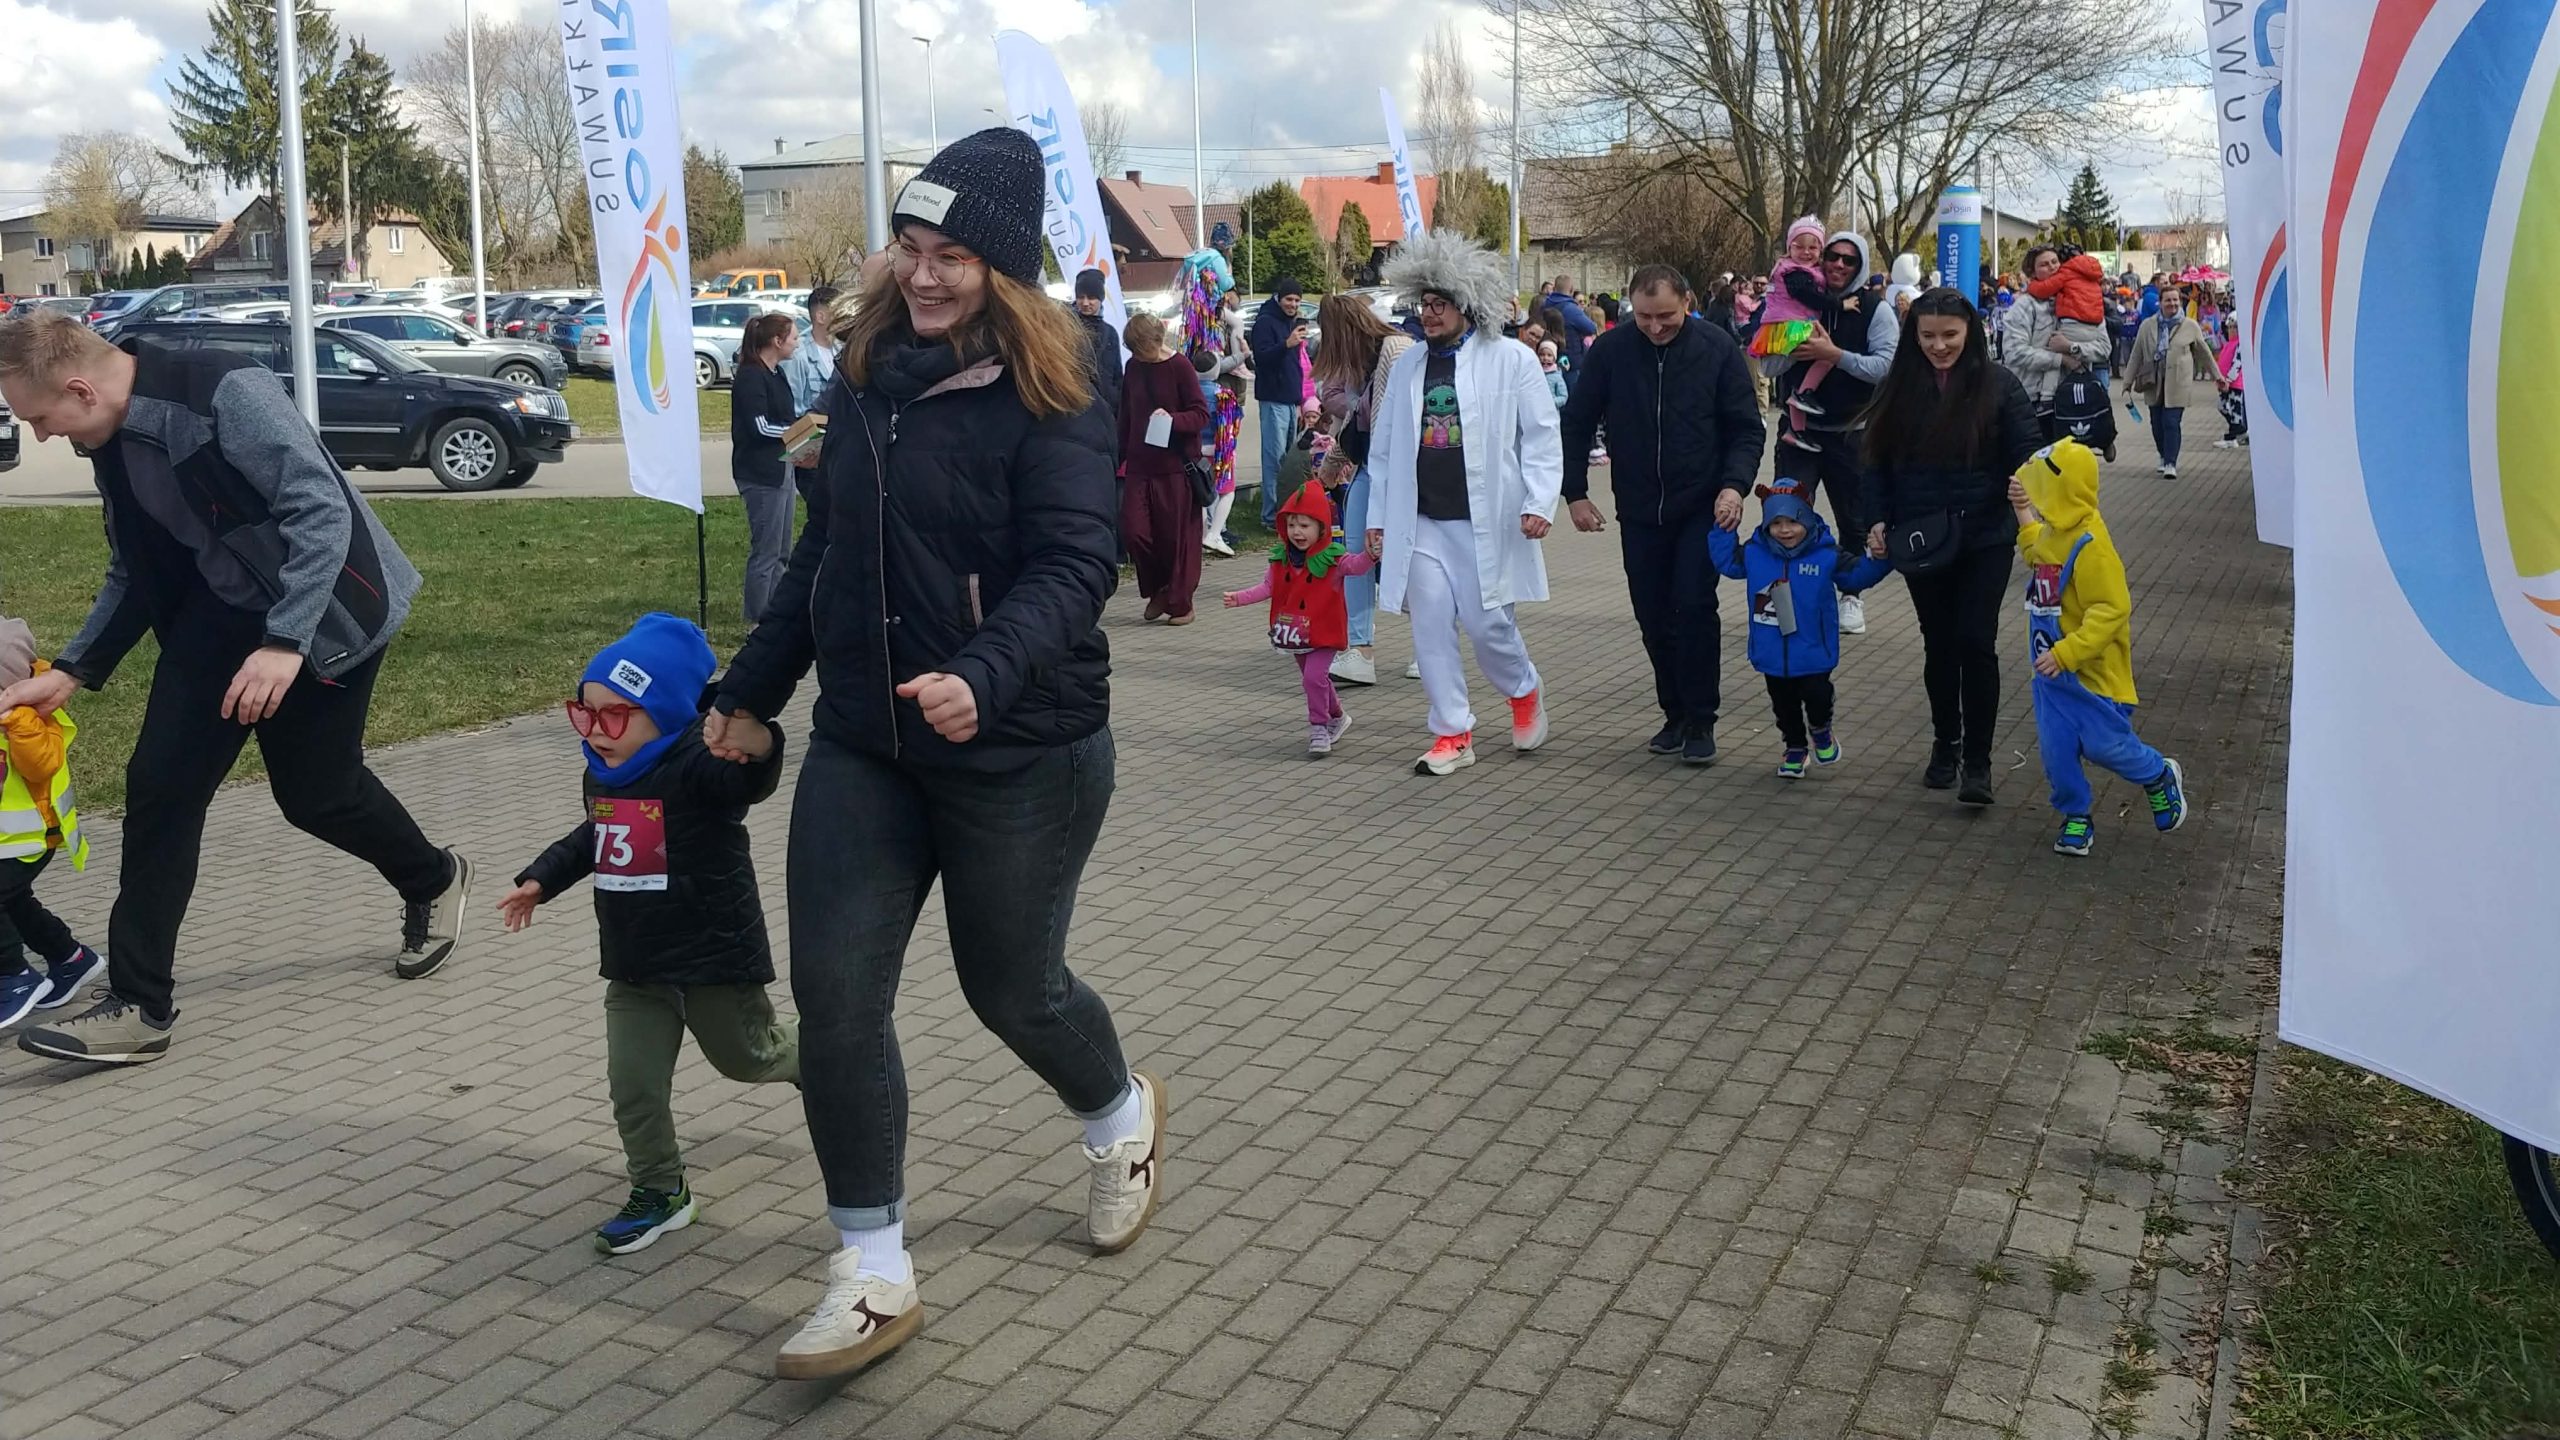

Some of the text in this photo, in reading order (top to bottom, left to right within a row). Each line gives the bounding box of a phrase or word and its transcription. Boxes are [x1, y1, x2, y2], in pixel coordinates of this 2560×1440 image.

[1799, 563, 1819, 576] HH
[1273, 623, 1302, 646] 274
[595, 822, 633, 867] 73
